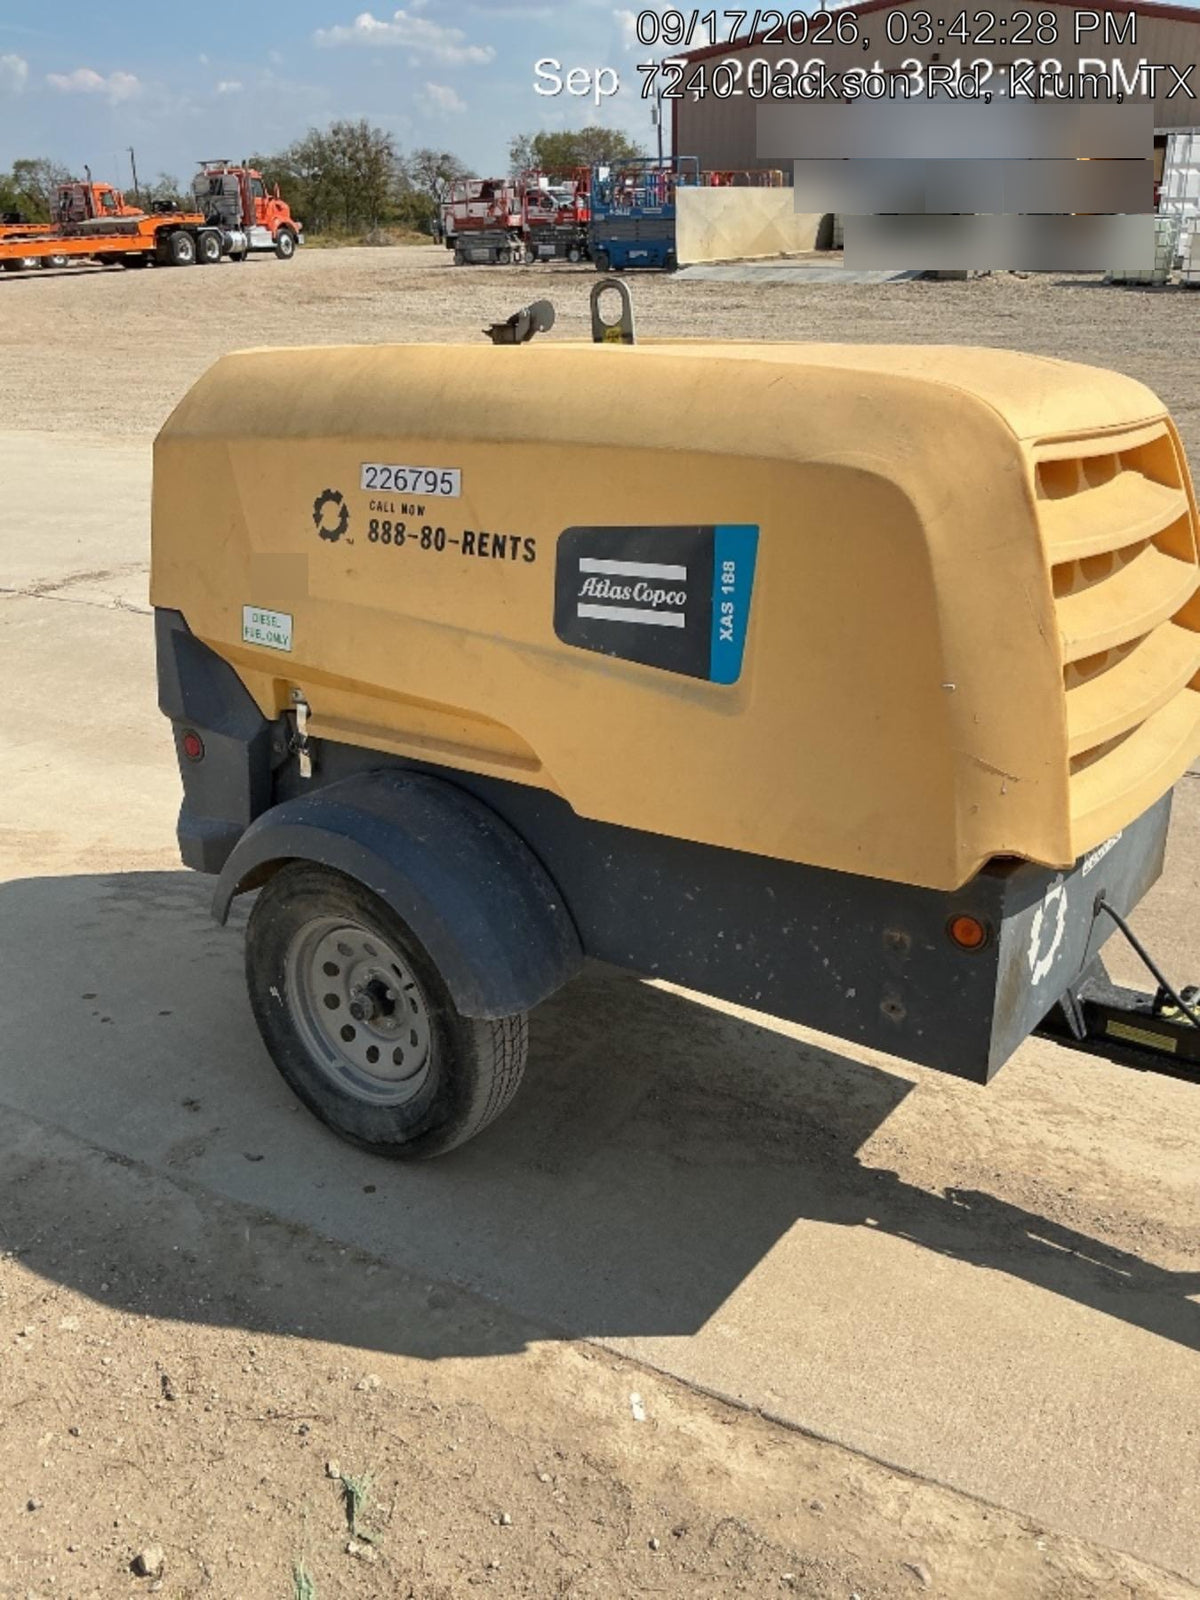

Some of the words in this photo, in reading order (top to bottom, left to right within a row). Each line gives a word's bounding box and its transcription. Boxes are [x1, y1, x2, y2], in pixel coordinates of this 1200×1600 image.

[366, 466, 453, 495] 226795
[369, 500, 395, 513] CALL
[401, 503, 425, 516] NOW
[368, 519, 536, 563] 888-80-RENTS
[720, 561, 736, 594] 188
[252, 613, 281, 628] DIESEL
[719, 602, 735, 643] XAS
[266, 630, 289, 646] ONLY
